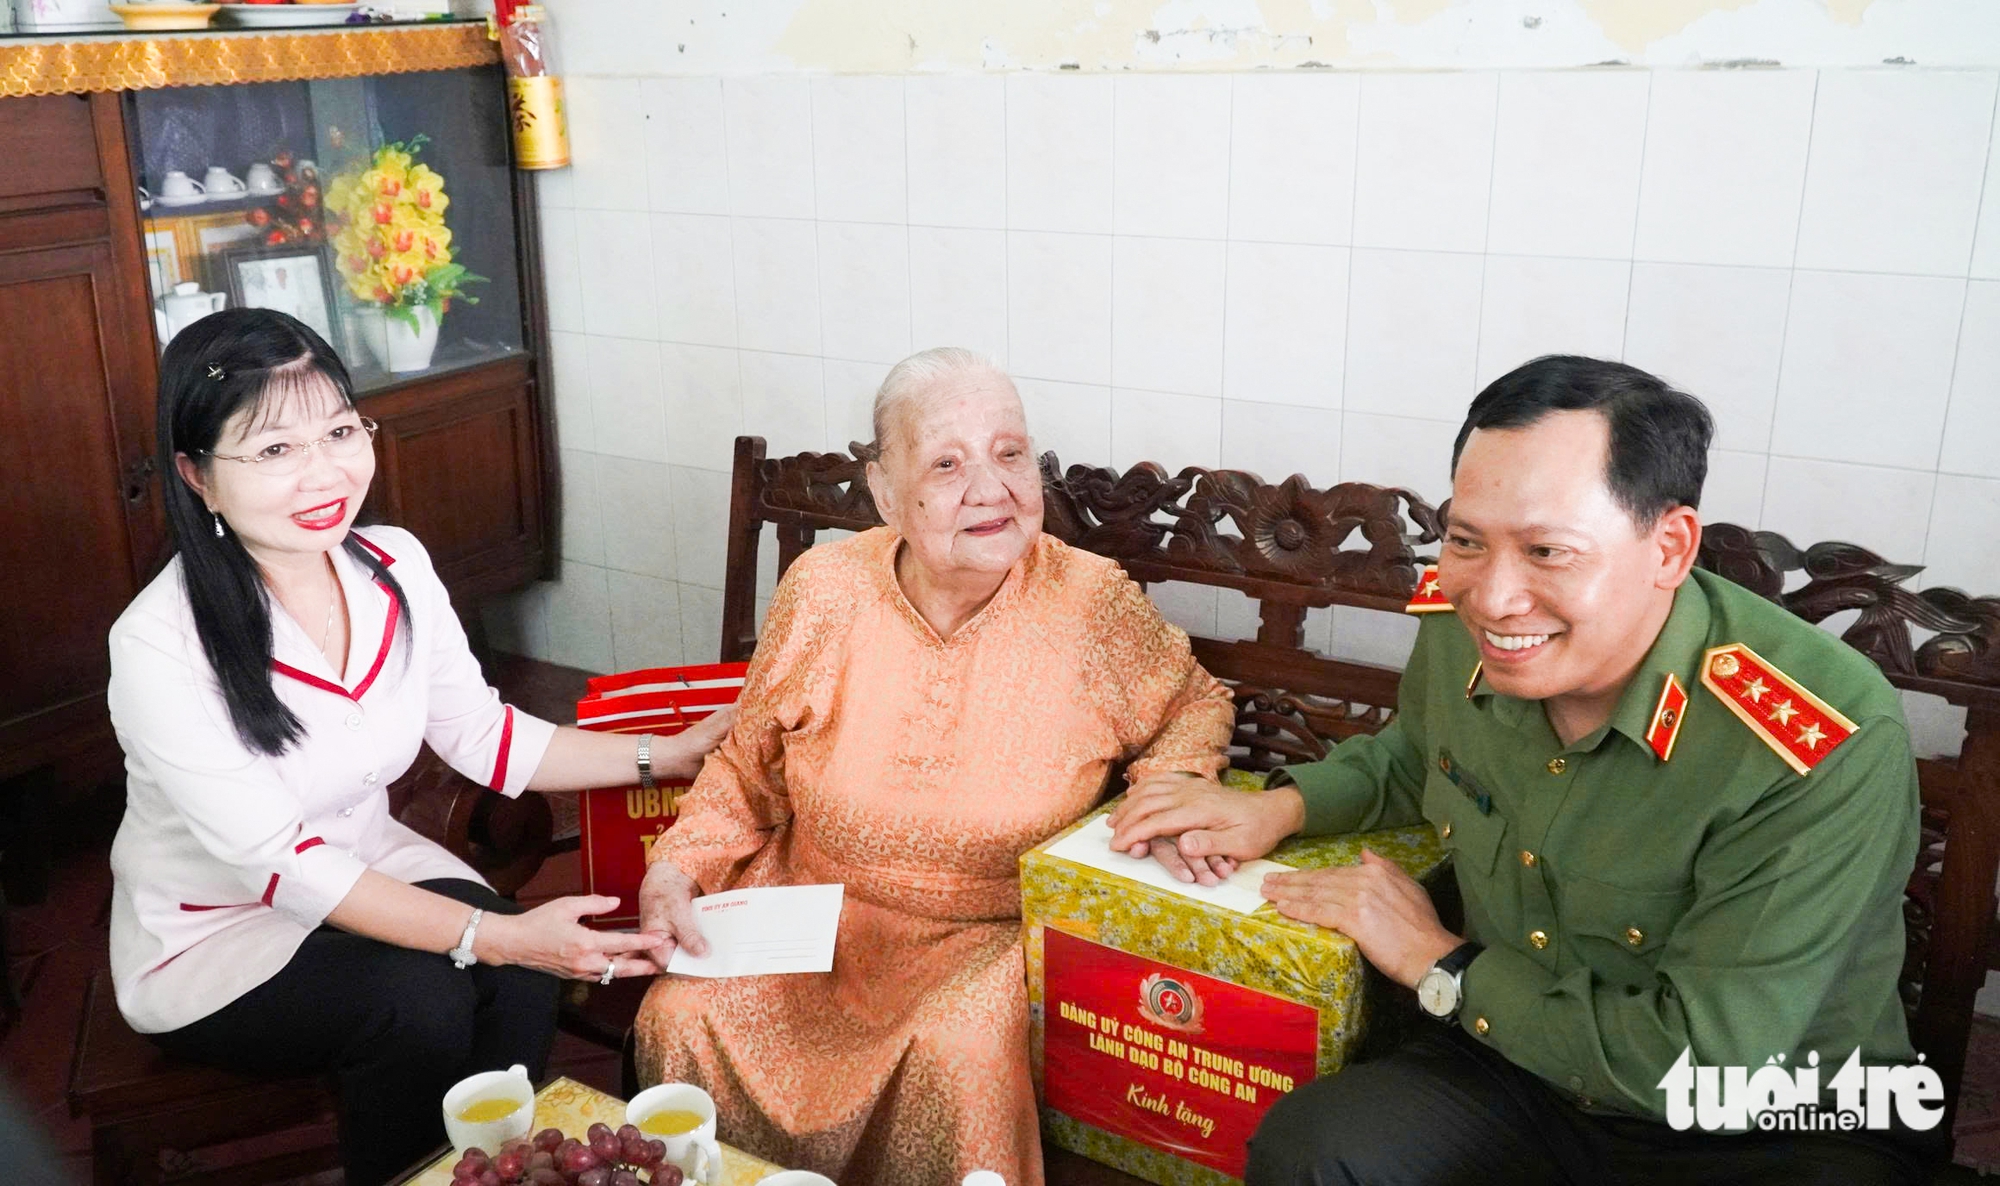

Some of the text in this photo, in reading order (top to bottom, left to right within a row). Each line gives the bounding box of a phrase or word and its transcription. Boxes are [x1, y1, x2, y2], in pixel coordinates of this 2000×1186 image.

[626, 785, 692, 819] UBM
[1060, 1001, 1096, 1030] ĐẢNG
[1123, 1024, 1163, 1052] CÔNG
[1168, 1039, 1188, 1061] AN
[1192, 1046, 1244, 1079] TRUNG
[1249, 1065, 1294, 1094] ƯƠNG
[1089, 1032, 1256, 1104] LÃNH ĐẠO BỘ CÔNG AN
[1176, 1100, 1215, 1138] tặng
